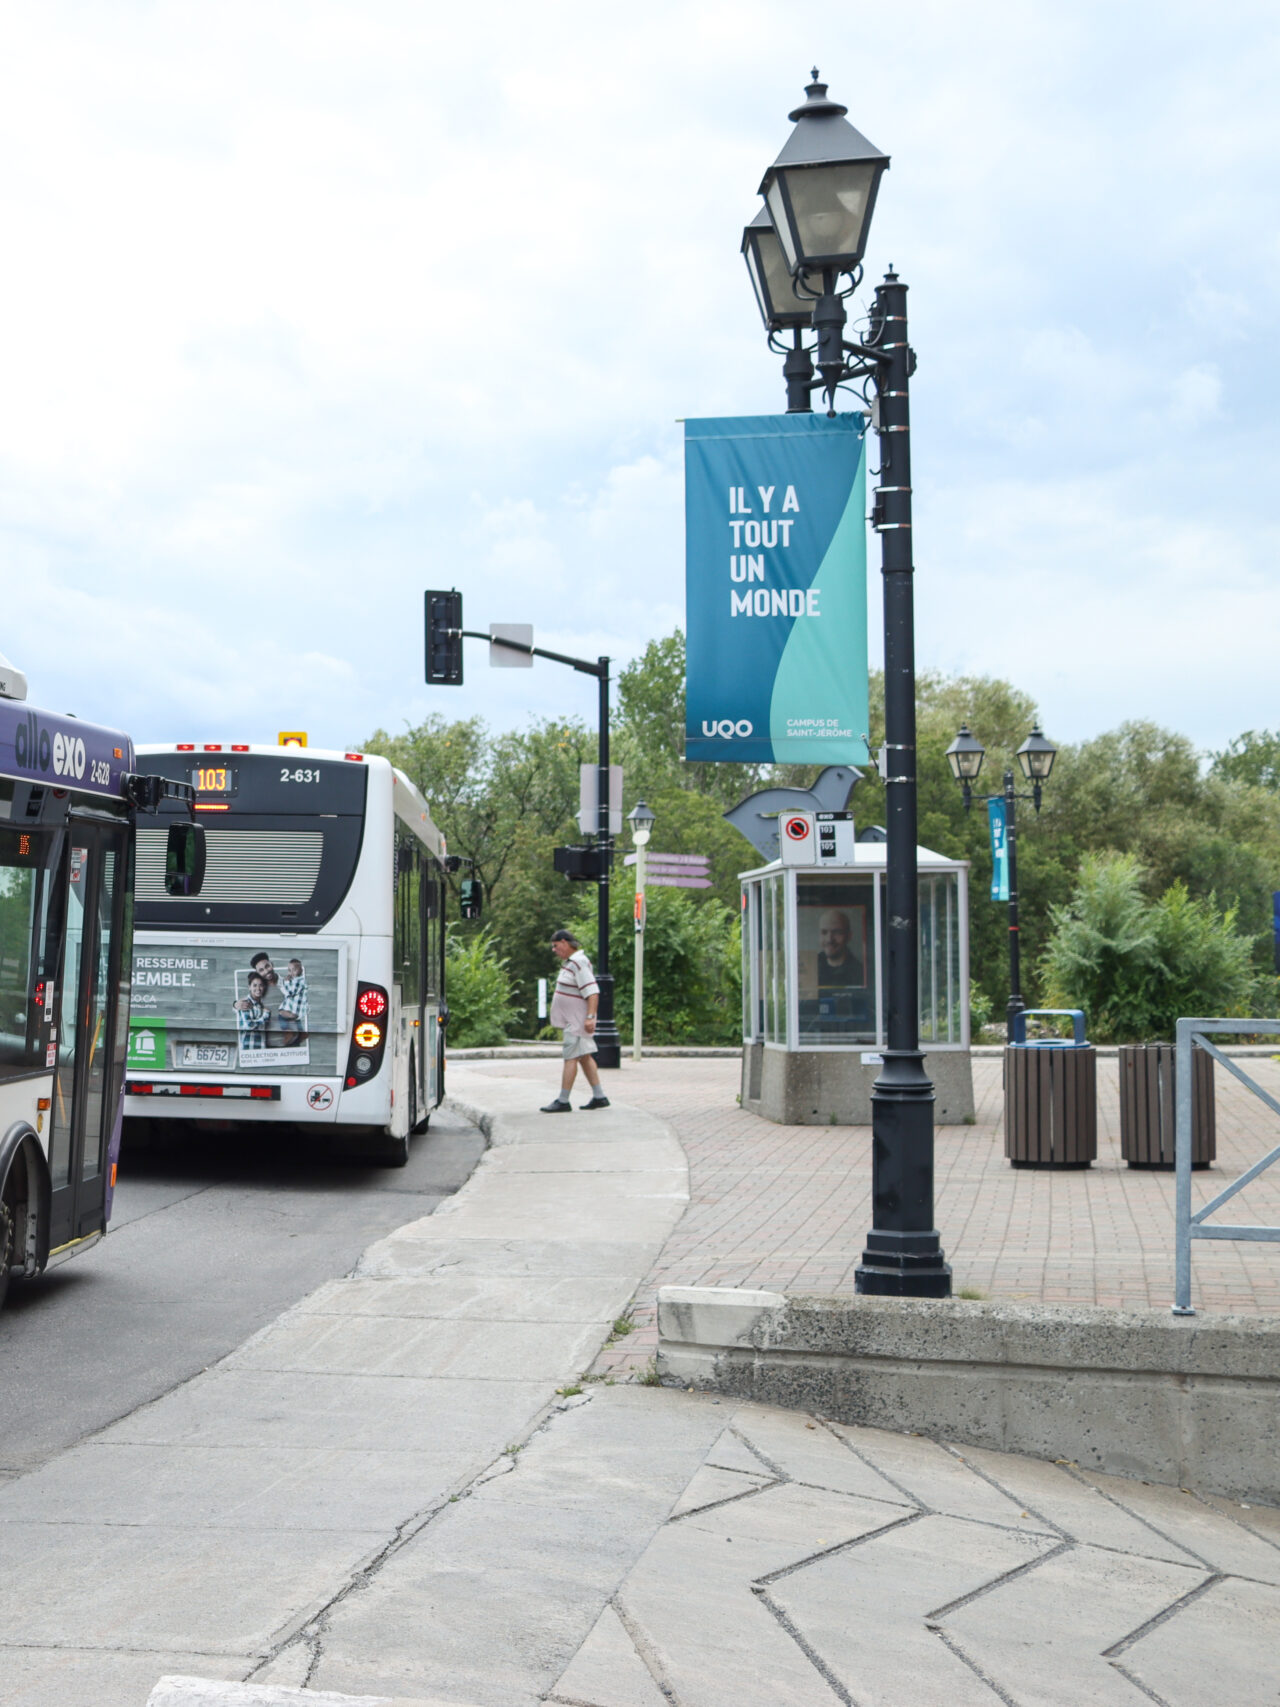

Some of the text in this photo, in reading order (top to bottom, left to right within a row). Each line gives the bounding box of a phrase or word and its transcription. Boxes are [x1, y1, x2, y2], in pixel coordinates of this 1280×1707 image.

[729, 485, 800, 514] IL Y A
[728, 520, 794, 548] TOUT
[730, 554, 765, 582] UN
[730, 588, 821, 617] MONDE
[702, 719, 753, 739] UQO
[787, 719, 839, 727] CAMPUS DE
[787, 727, 853, 737] SAINT-JÉRÔME
[15, 710, 86, 780] allo exo
[90, 759, 110, 786] 2-628
[198, 769, 226, 791] 103
[280, 768, 320, 783] 2-631
[136, 957, 209, 970] RESSEMBLE
[196, 1049, 228, 1061] 66752
[241, 1052, 278, 1060] COLLECTION
